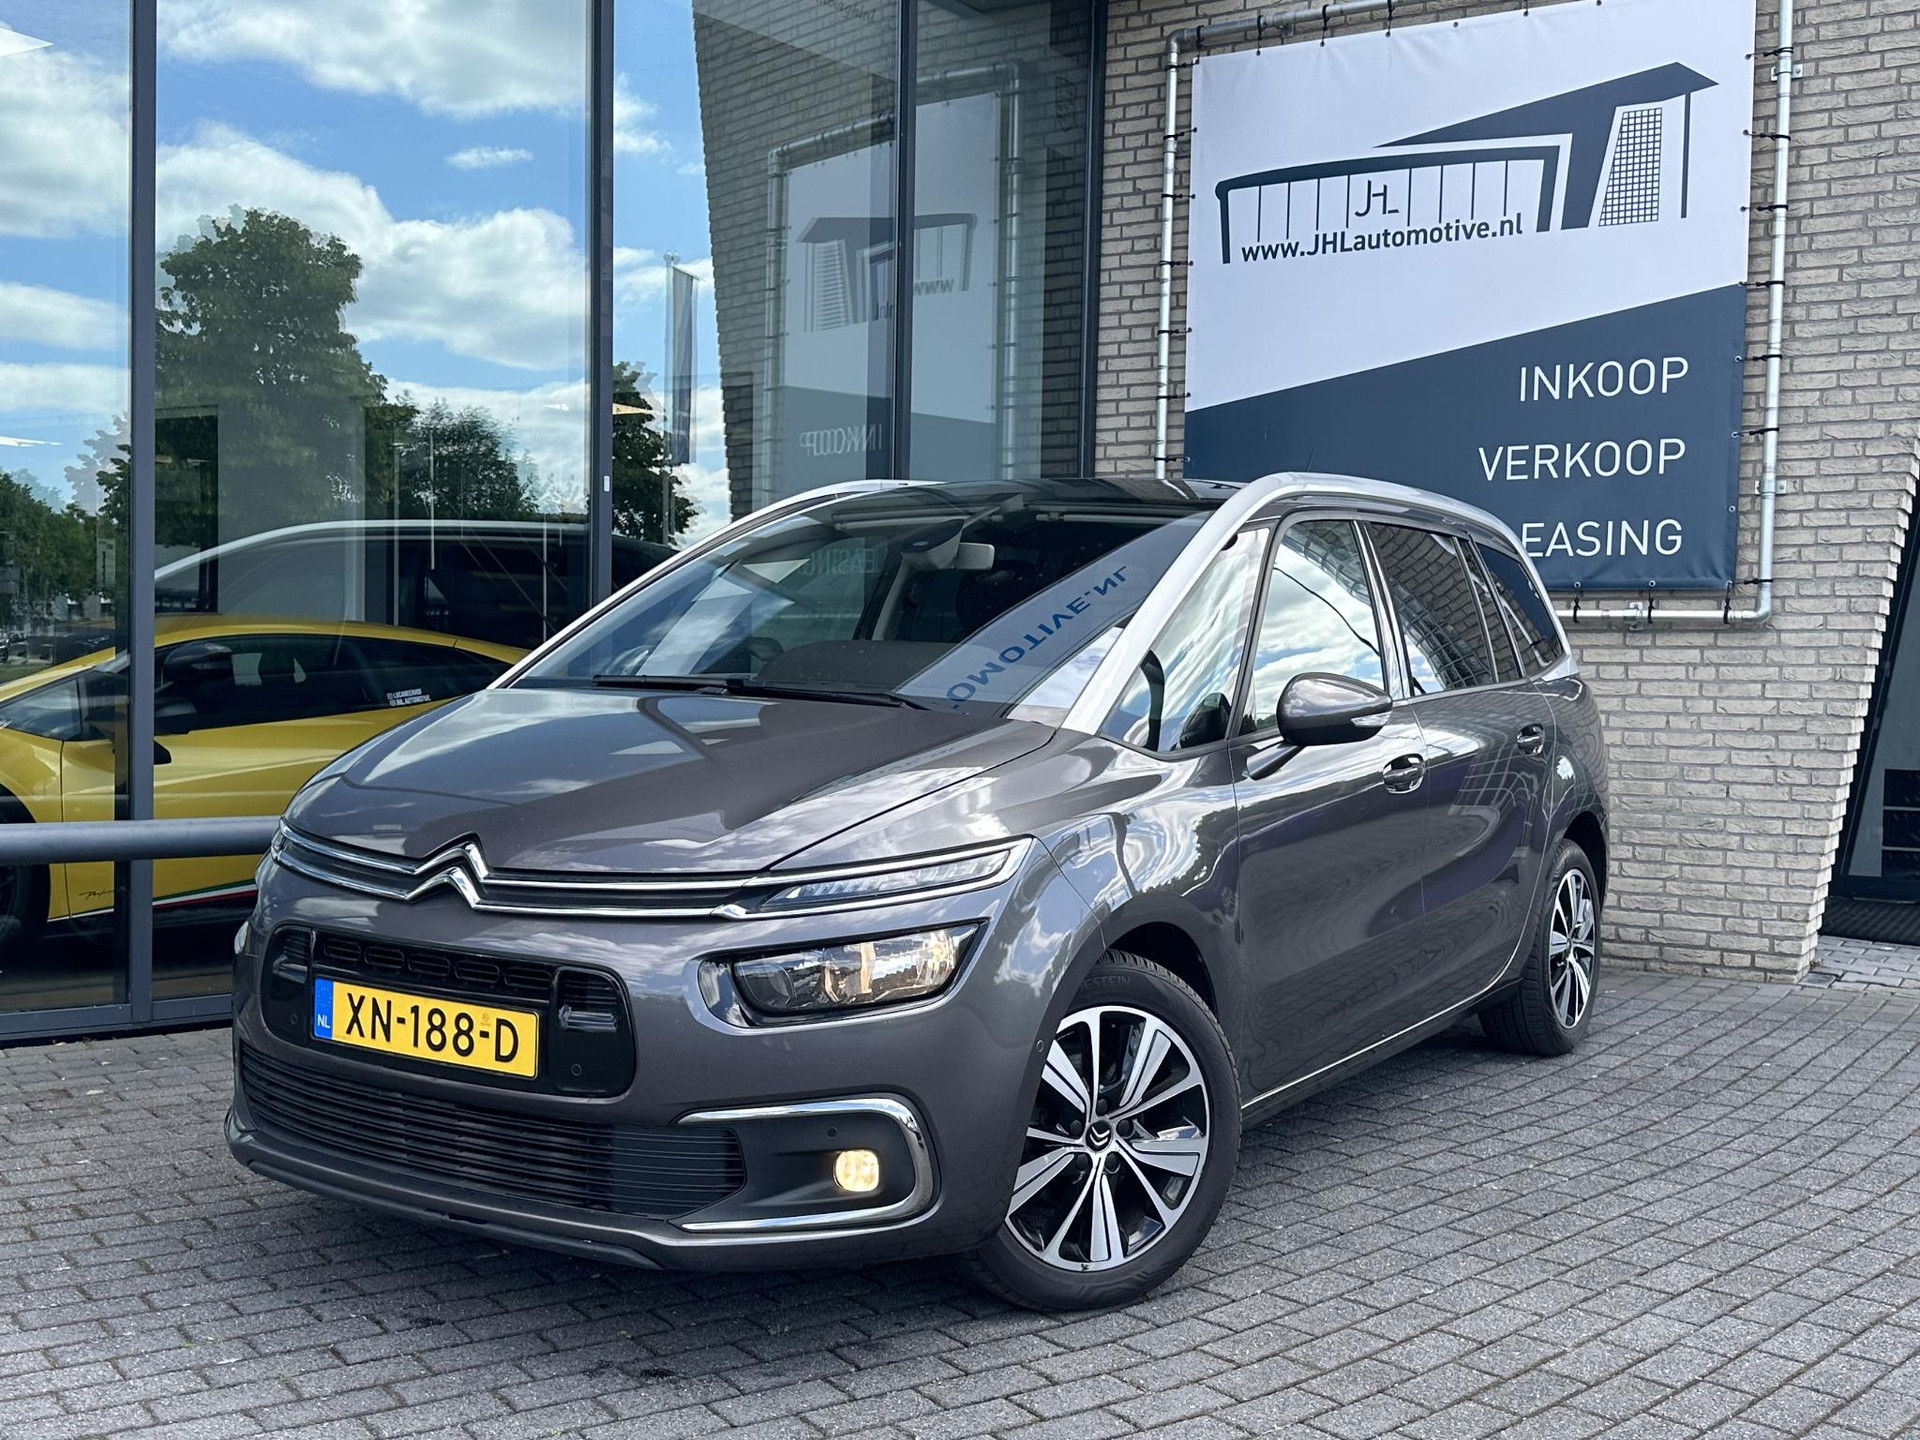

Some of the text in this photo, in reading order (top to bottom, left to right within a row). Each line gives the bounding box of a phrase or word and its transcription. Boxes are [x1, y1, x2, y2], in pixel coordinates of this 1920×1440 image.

[1241, 212, 1523, 262] www.JHLautomotive.nl
[1519, 356, 1689, 402] INKOOP
[1478, 438, 1686, 481] VERKOOP
[1522, 518, 1683, 558] EASING
[317, 1013, 331, 1029] NL
[345, 992, 519, 1063] XN-188-D
